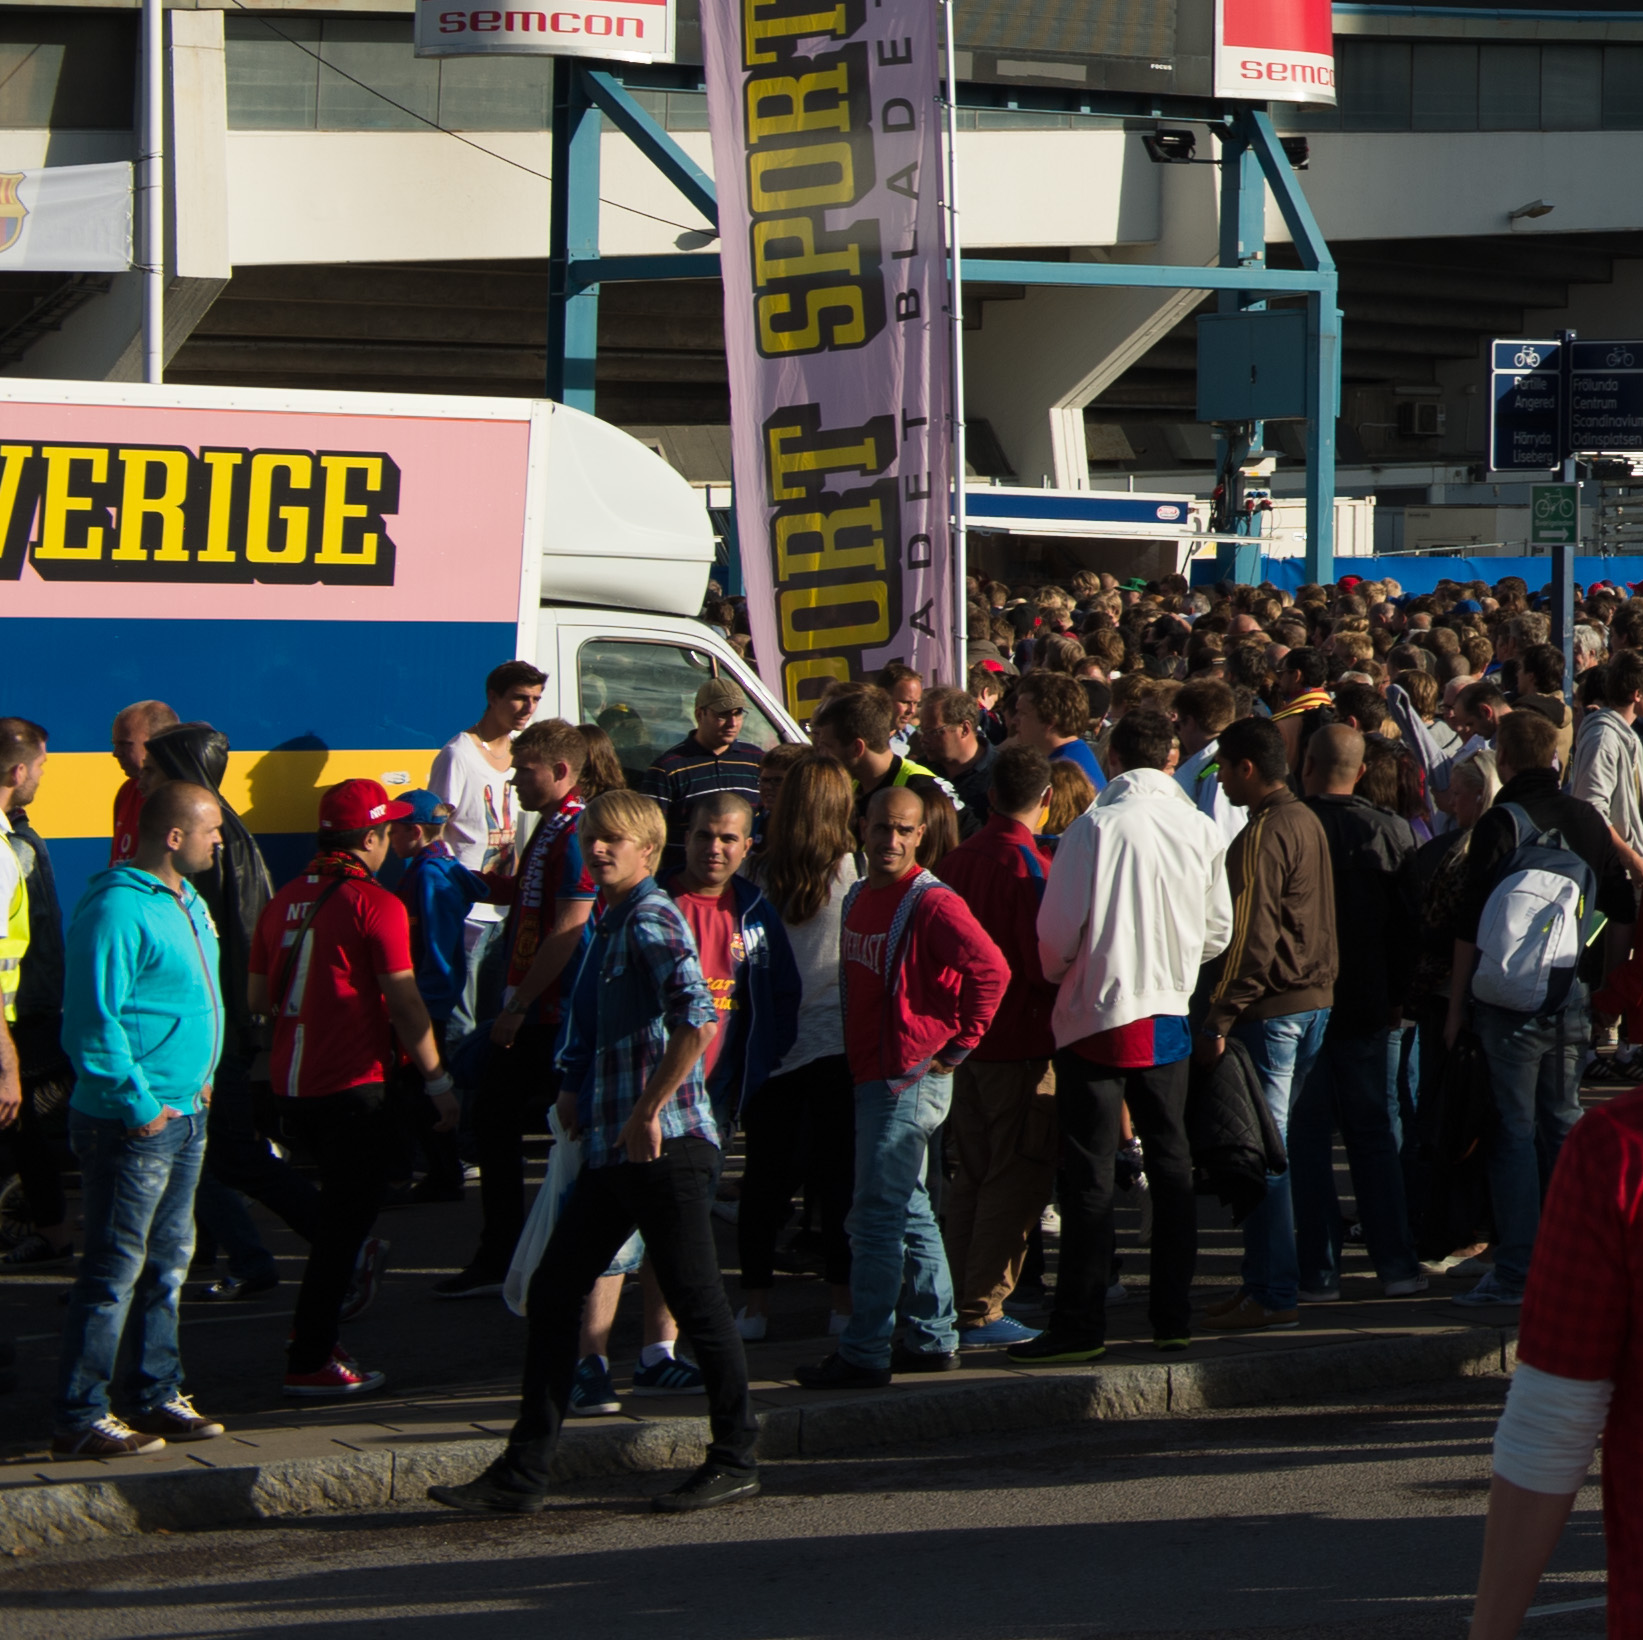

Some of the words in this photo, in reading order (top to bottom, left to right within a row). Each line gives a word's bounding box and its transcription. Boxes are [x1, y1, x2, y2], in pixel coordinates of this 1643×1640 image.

[438, 10, 645, 39] semcon
[1151, 62, 1173, 71] FOCUS
[1514, 376, 1548, 390] Partille
[1572, 378, 1619, 391] Frölunda
[1514, 395, 1555, 412] Angered
[1572, 397, 1618, 410] Centrum
[1513, 431, 1552, 447] Härryda
[1572, 434, 1643, 447] Odinsplatsen
[1513, 450, 1553, 466] Liseberg
